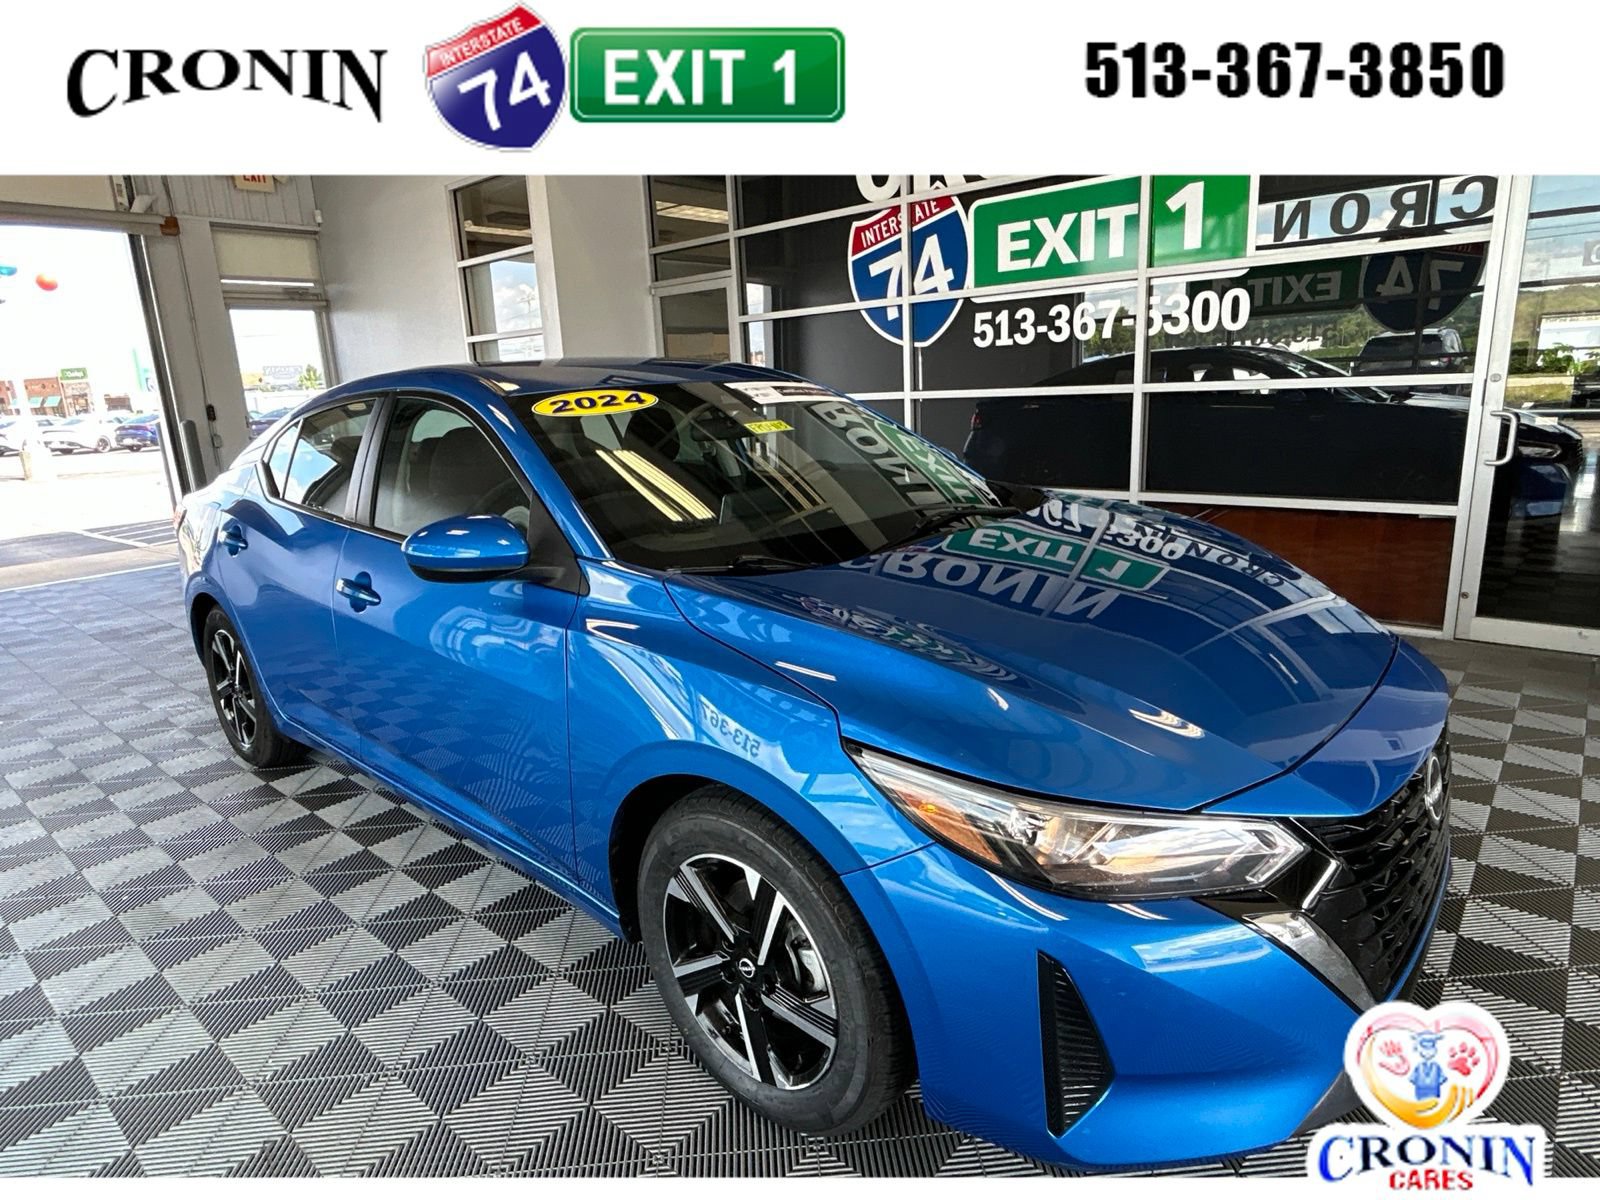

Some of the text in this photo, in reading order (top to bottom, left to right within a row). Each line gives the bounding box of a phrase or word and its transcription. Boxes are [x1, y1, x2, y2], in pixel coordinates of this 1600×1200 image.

[860, 200, 941, 248] INTERATE
[998, 181, 1205, 272] EXIT 1
[868, 233, 954, 321] 74
[973, 287, 1250, 348] 513-367-5300
[549, 392, 646, 413] 2024
